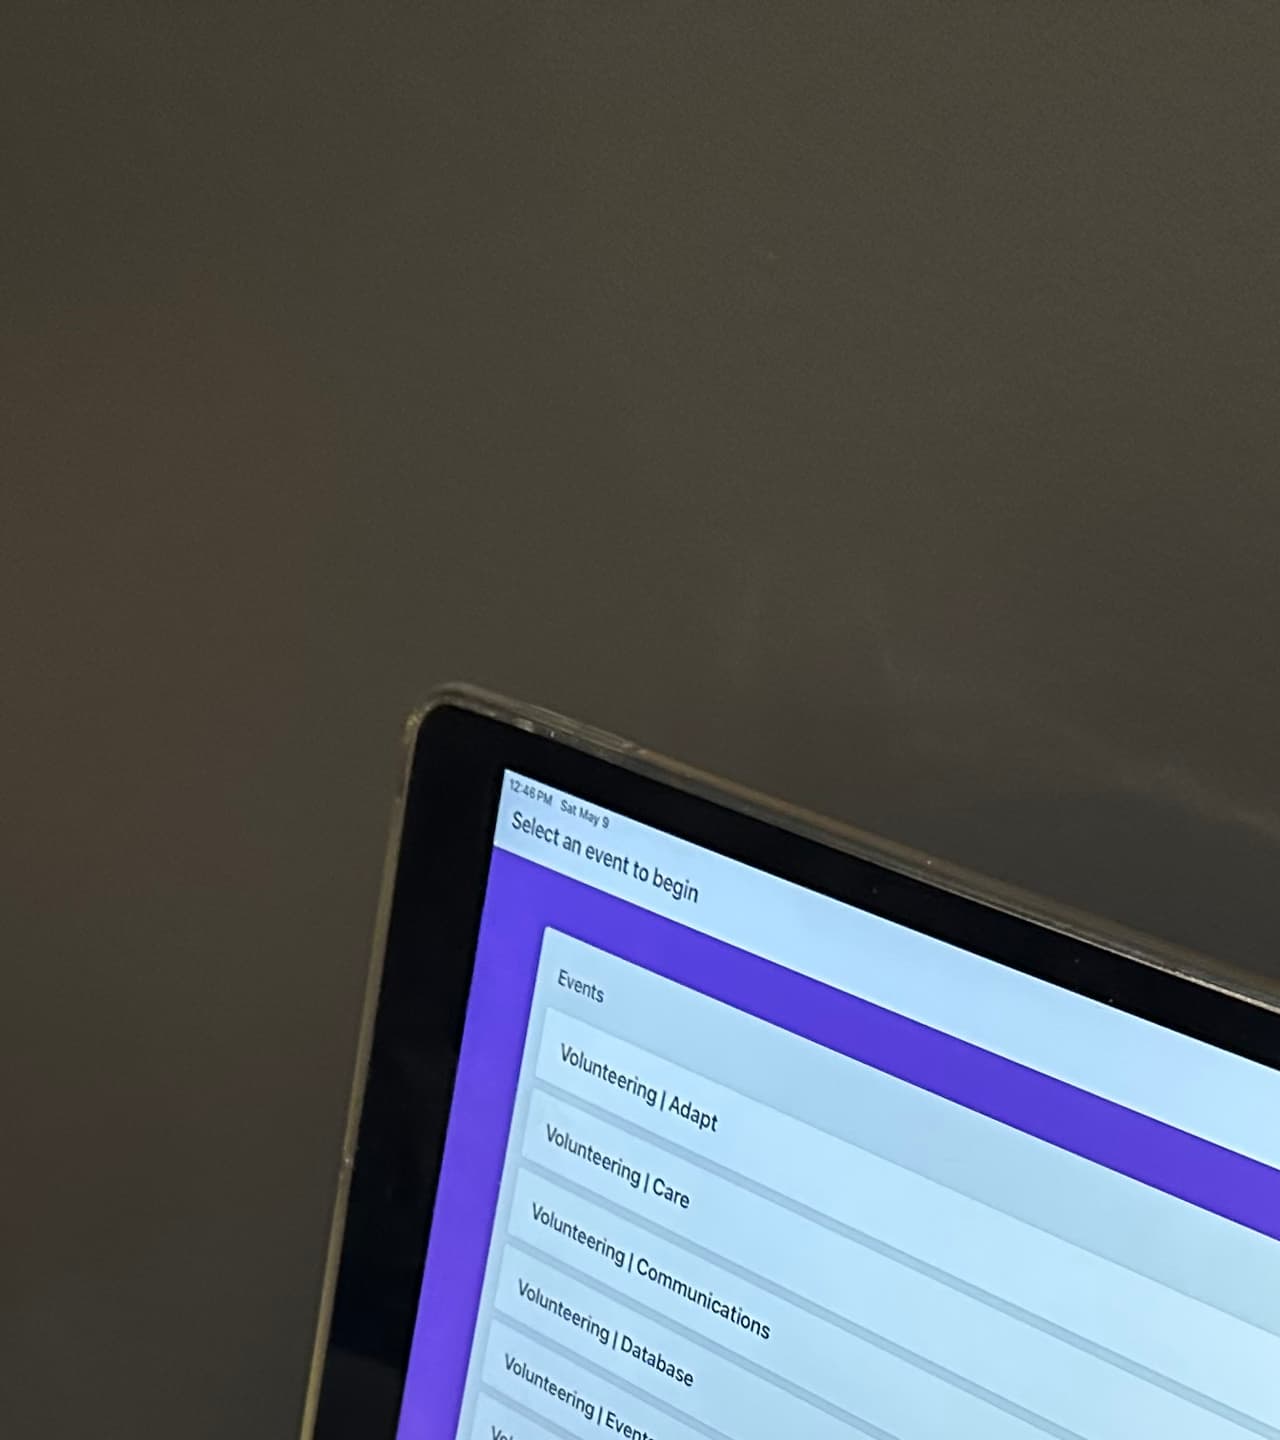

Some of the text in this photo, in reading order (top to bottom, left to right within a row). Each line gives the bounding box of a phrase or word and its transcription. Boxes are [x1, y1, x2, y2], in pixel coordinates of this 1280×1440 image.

[510, 779, 553, 806] 12:46 PM
[560, 800, 610, 829] Sat May 9
[511, 811, 699, 903] Select an event to begin
[558, 969, 605, 1003] Events
[561, 1043, 658, 1107] Volunteering
[669, 1095, 719, 1132] Adapt
[546, 1123, 641, 1189] Volunteering
[652, 1177, 690, 1208] Care
[532, 1202, 625, 1268] Volunteering
[636, 1258, 771, 1340] Communications
[518, 1278, 610, 1345] Volunteering
[620, 1335, 694, 1387] Database
[504, 1353, 595, 1420] Volunteering
